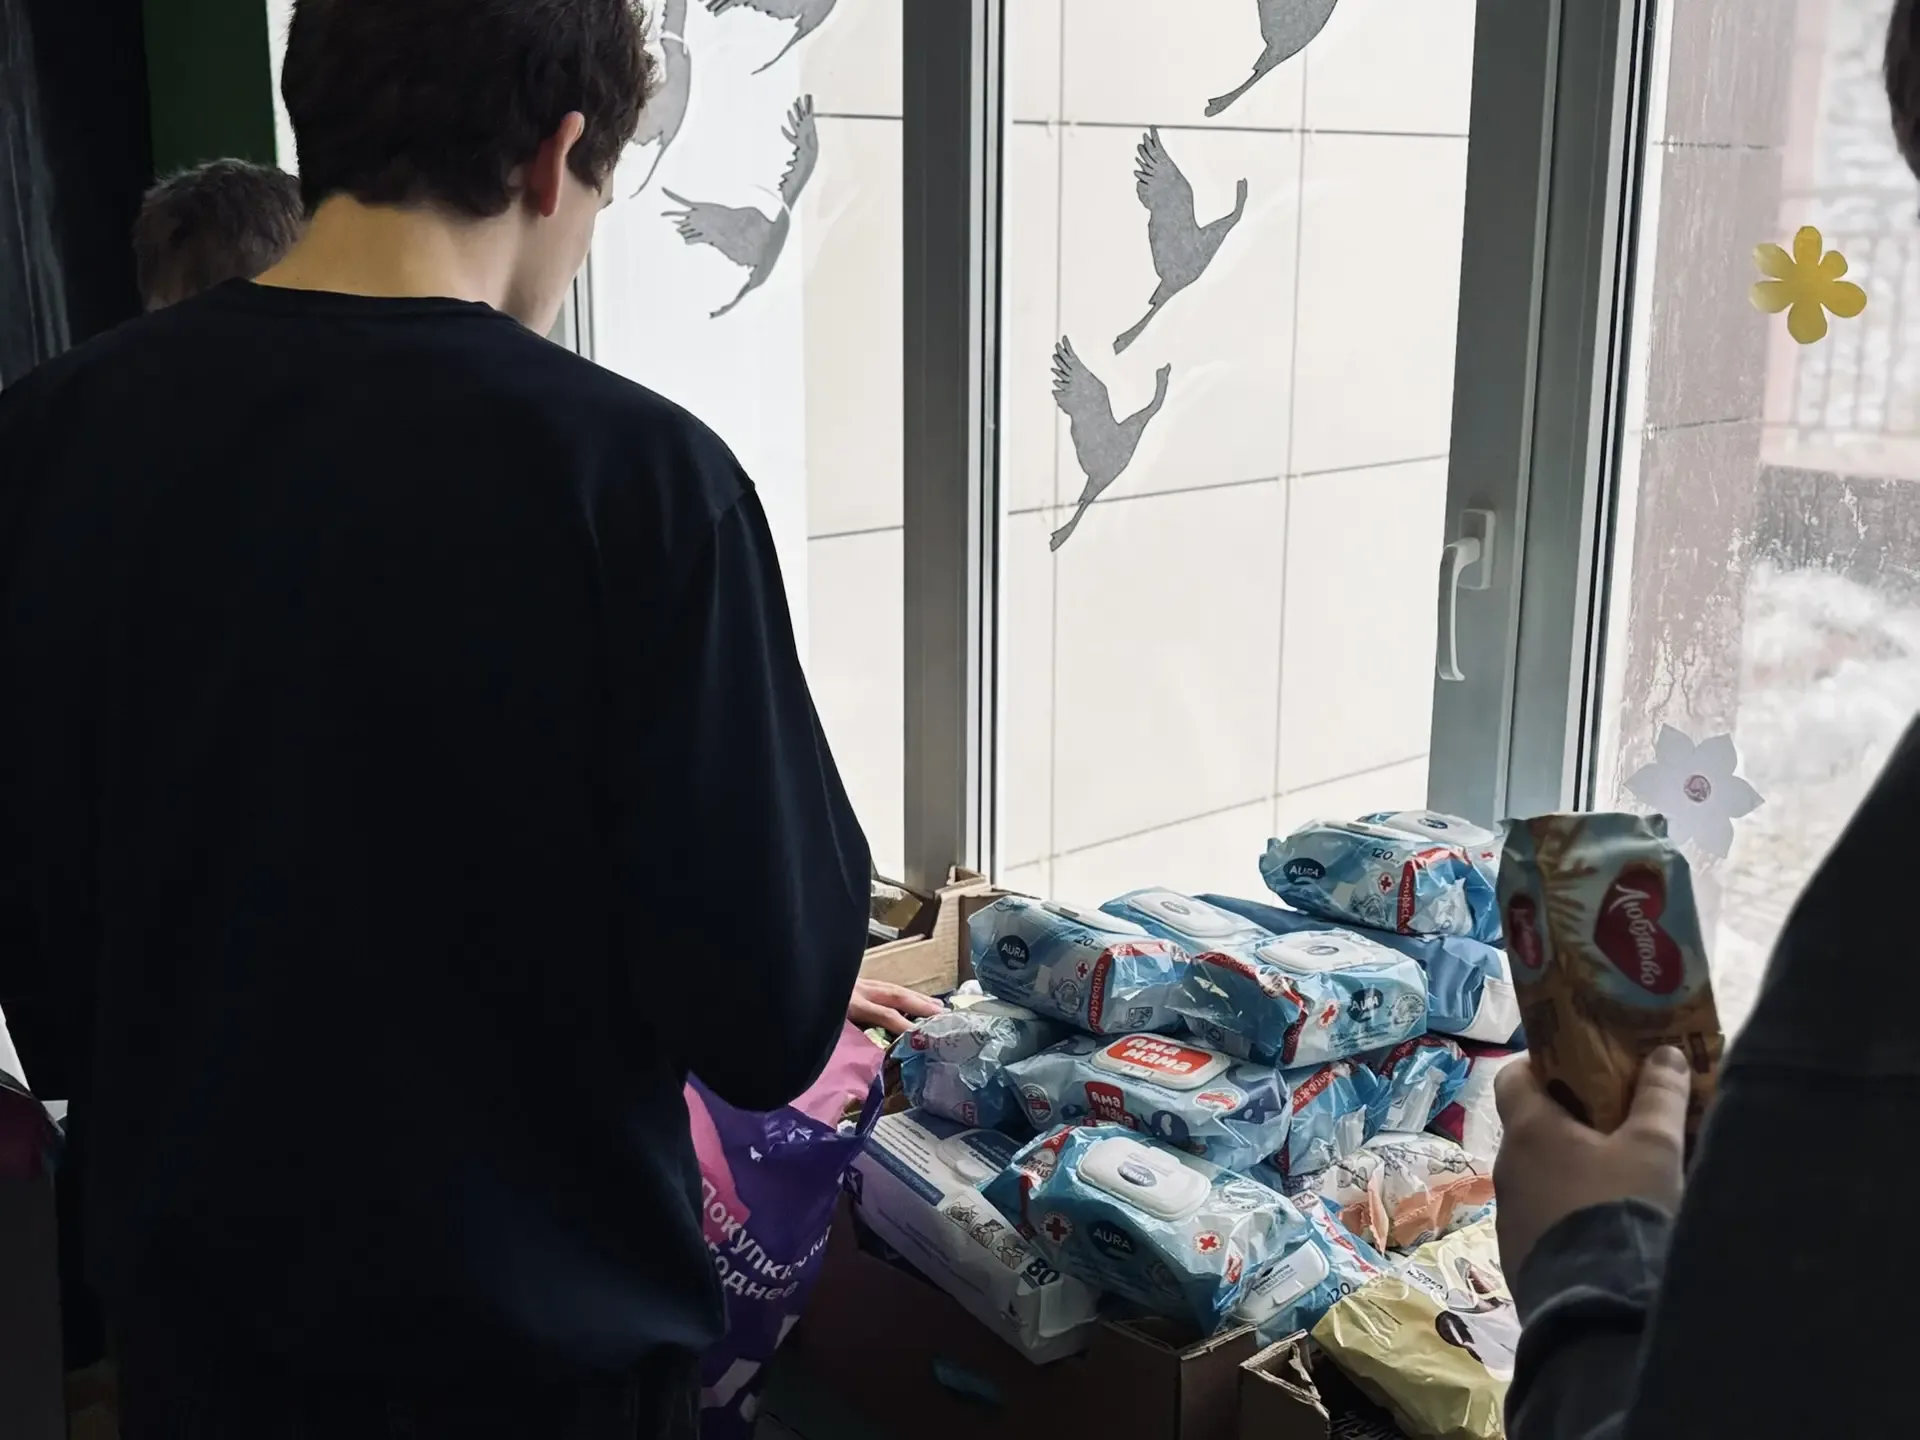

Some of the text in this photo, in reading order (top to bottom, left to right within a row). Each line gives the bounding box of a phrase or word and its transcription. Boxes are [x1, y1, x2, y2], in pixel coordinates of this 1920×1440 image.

[1371, 847, 1394, 861] 120
[1001, 942, 1026, 959] AURA
[1351, 995, 1379, 1012] AURA
[1093, 1227, 1132, 1251] AURA
[1027, 1256, 1060, 1286] 80
[1327, 1282, 1351, 1304] 120
